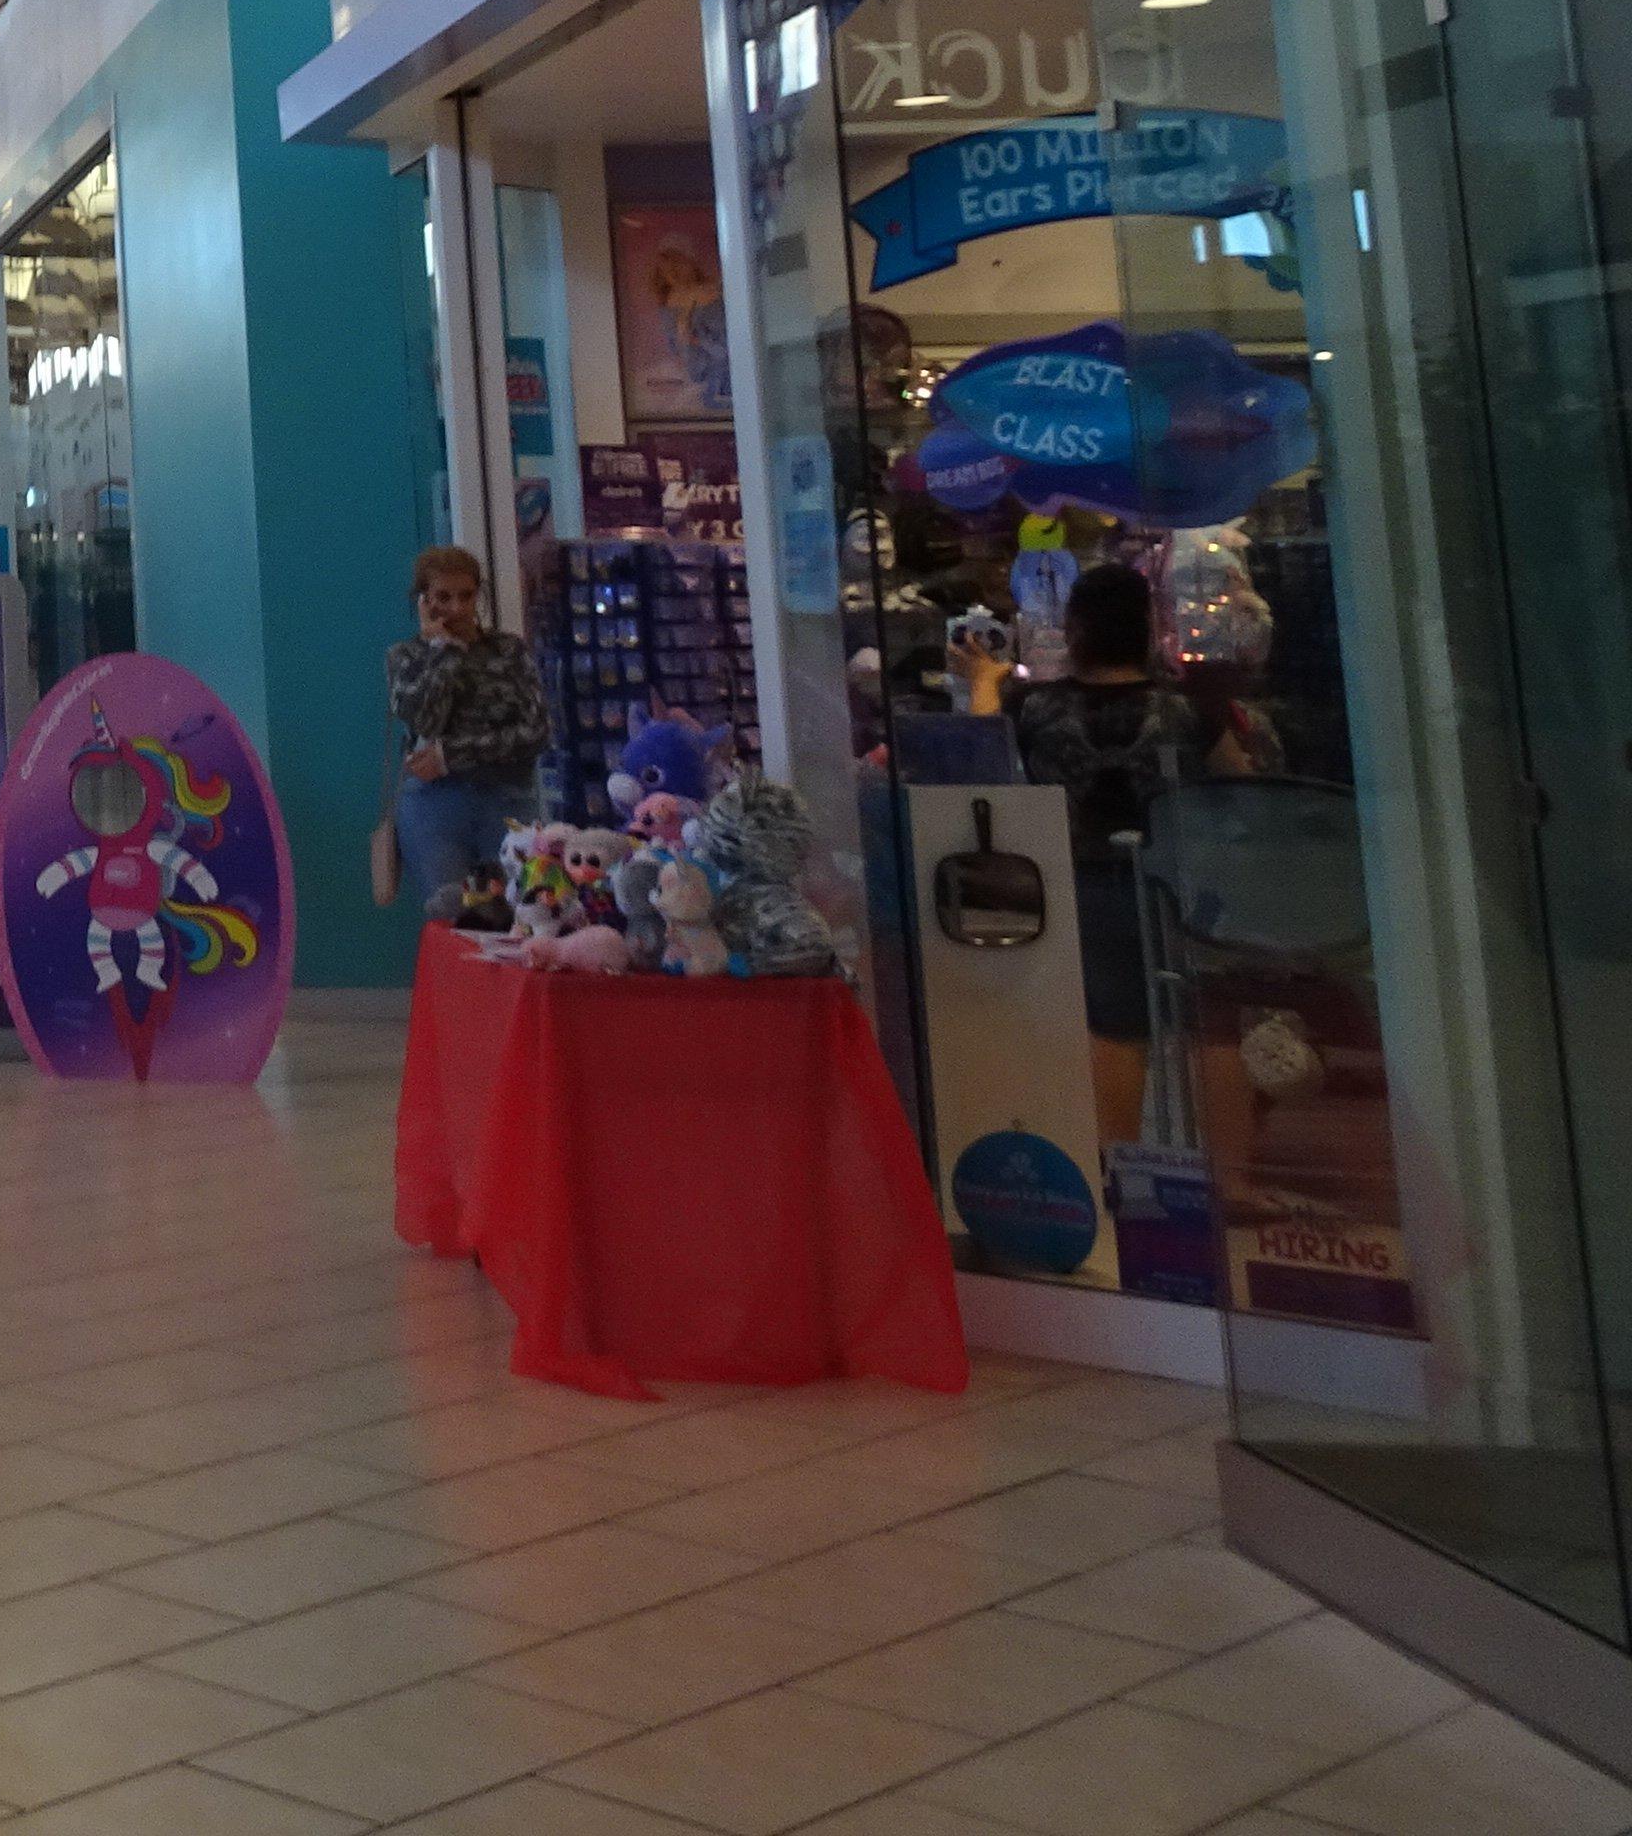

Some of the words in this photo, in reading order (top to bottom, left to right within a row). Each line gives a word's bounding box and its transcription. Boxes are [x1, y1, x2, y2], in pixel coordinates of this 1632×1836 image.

[959, 137, 1024, 182] 100
[956, 181, 1055, 226] Ears
[1064, 160, 1243, 209] Pirced
[1012, 354, 1127, 397] BLAST
[991, 411, 1105, 461] CLASS
[1257, 1226, 1390, 1272] HIRING
